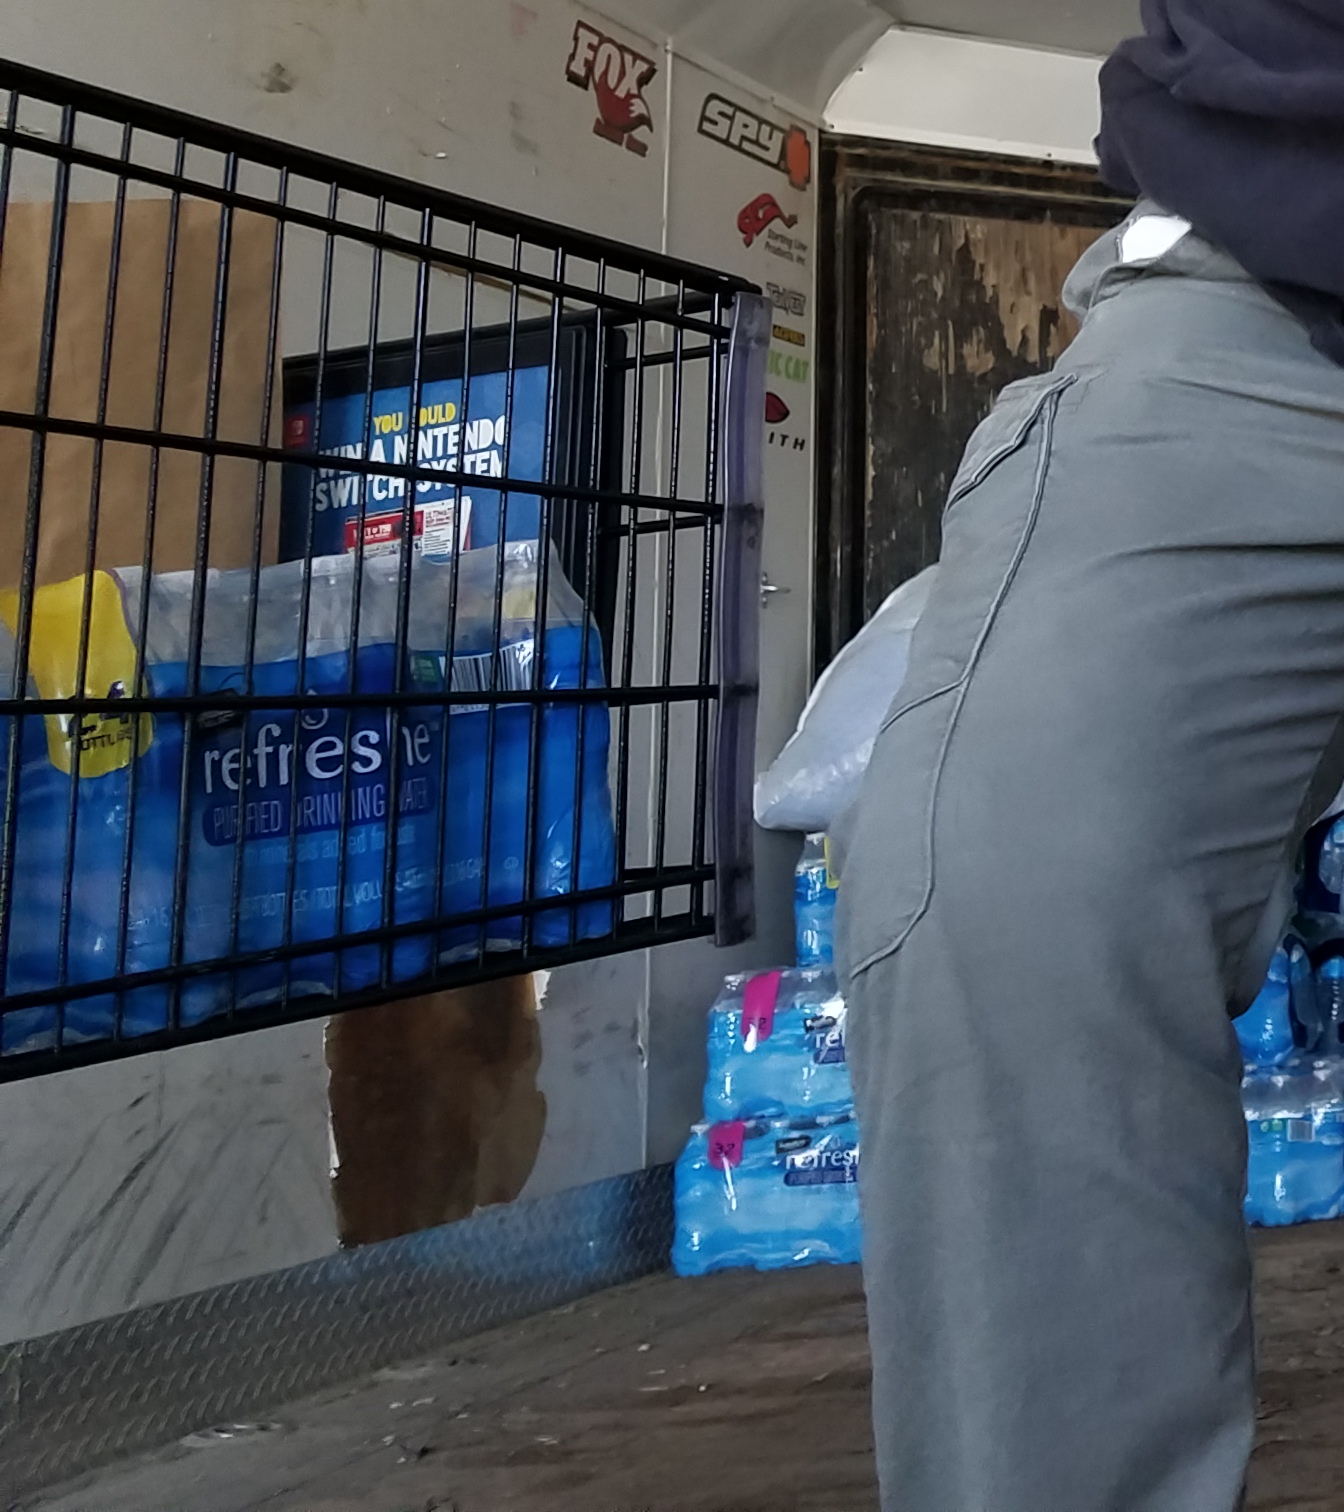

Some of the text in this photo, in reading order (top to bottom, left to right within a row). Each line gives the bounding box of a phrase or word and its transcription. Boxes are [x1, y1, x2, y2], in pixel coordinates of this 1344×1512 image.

[568, 25, 652, 100] FOX
[701, 96, 785, 166] SPY
[784, 355, 809, 383] CAT
[373, 402, 456, 435] YOU OULD
[369, 439, 386, 464] A
[394, 415, 506, 465] NNTENDO
[768, 431, 806, 451] ITH
[316, 474, 404, 511] SWICH
